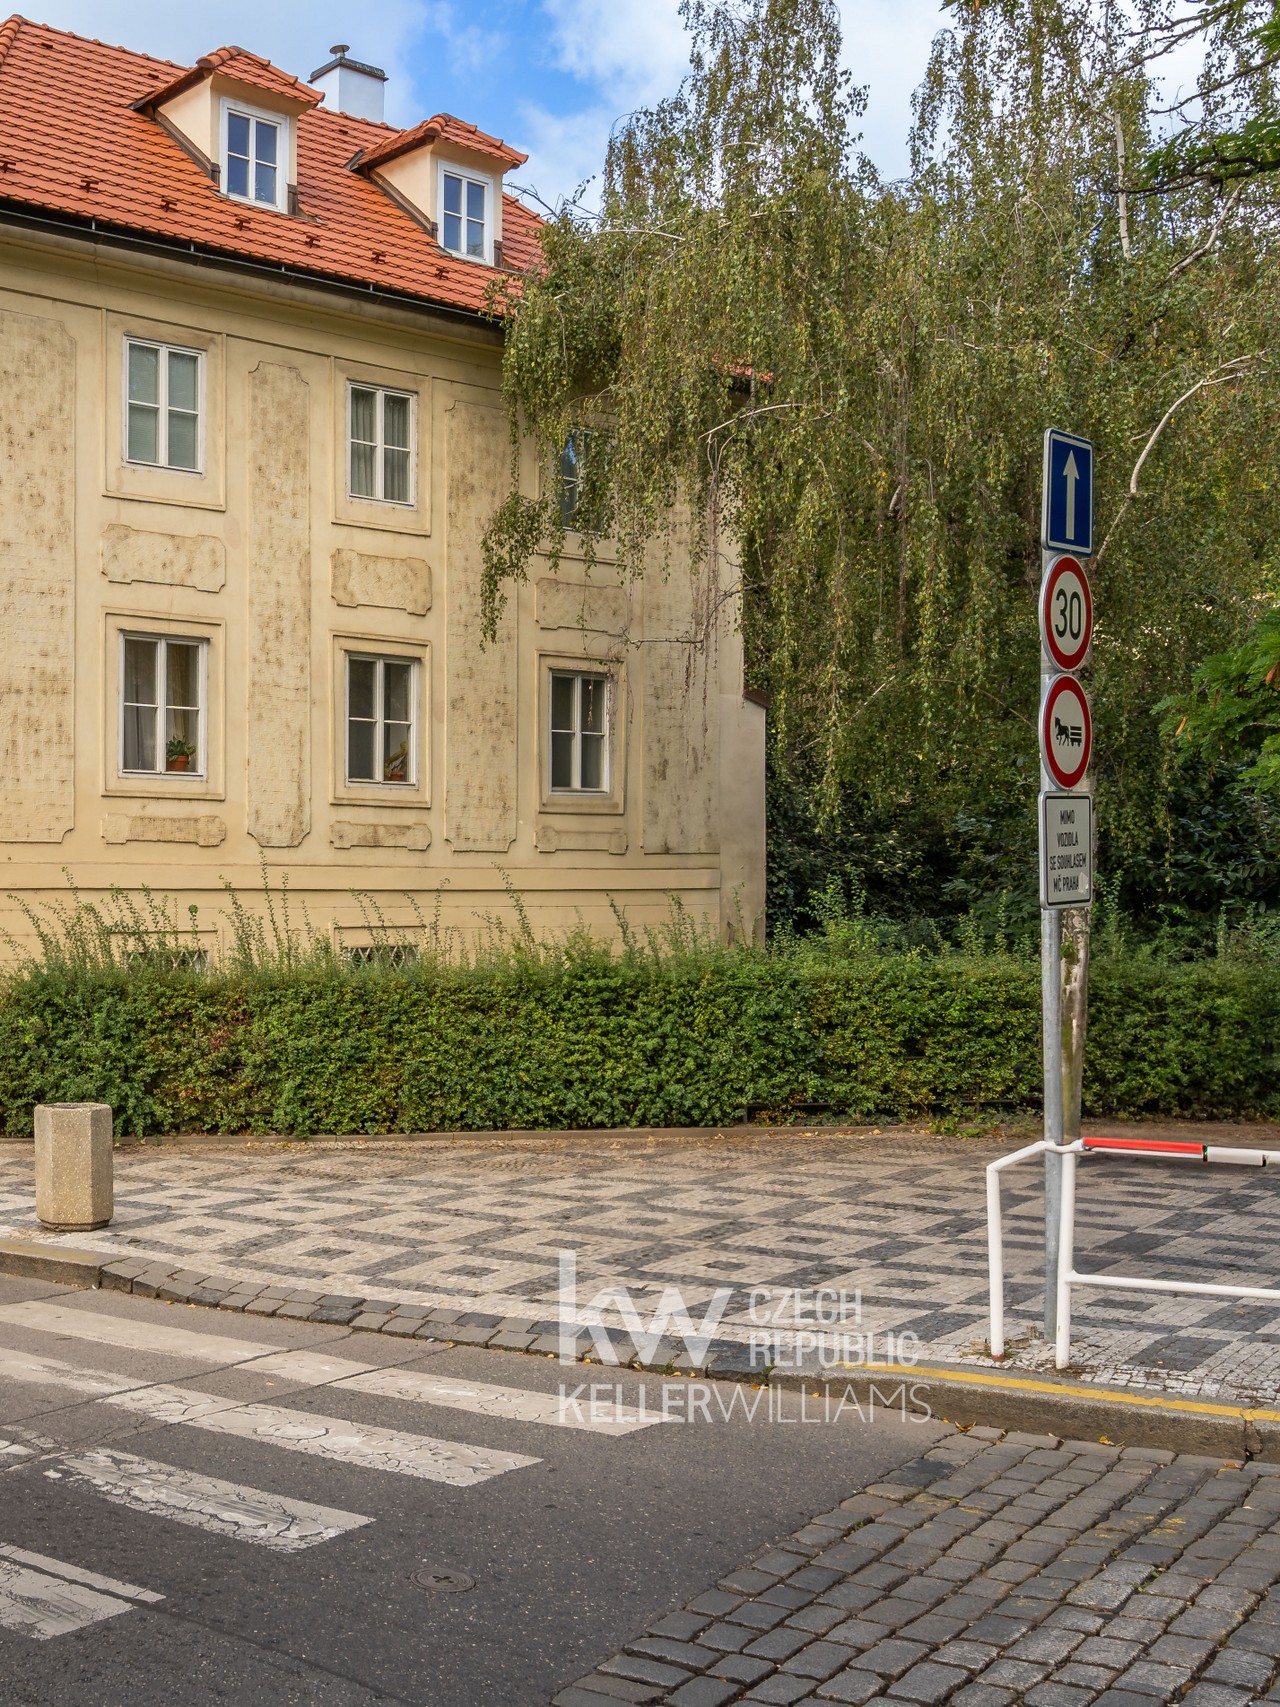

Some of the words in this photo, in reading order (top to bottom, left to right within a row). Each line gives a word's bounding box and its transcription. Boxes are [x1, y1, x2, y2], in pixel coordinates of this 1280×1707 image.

[1055, 588, 1082, 640] 30
[1060, 809, 1075, 824] MIMO
[1057, 832, 1079, 847] VOZIDLA
[1049, 855, 1057, 870] SE
[1057, 852, 1087, 869] SOUHLASEM
[1063, 875, 1079, 892] PRAHA
